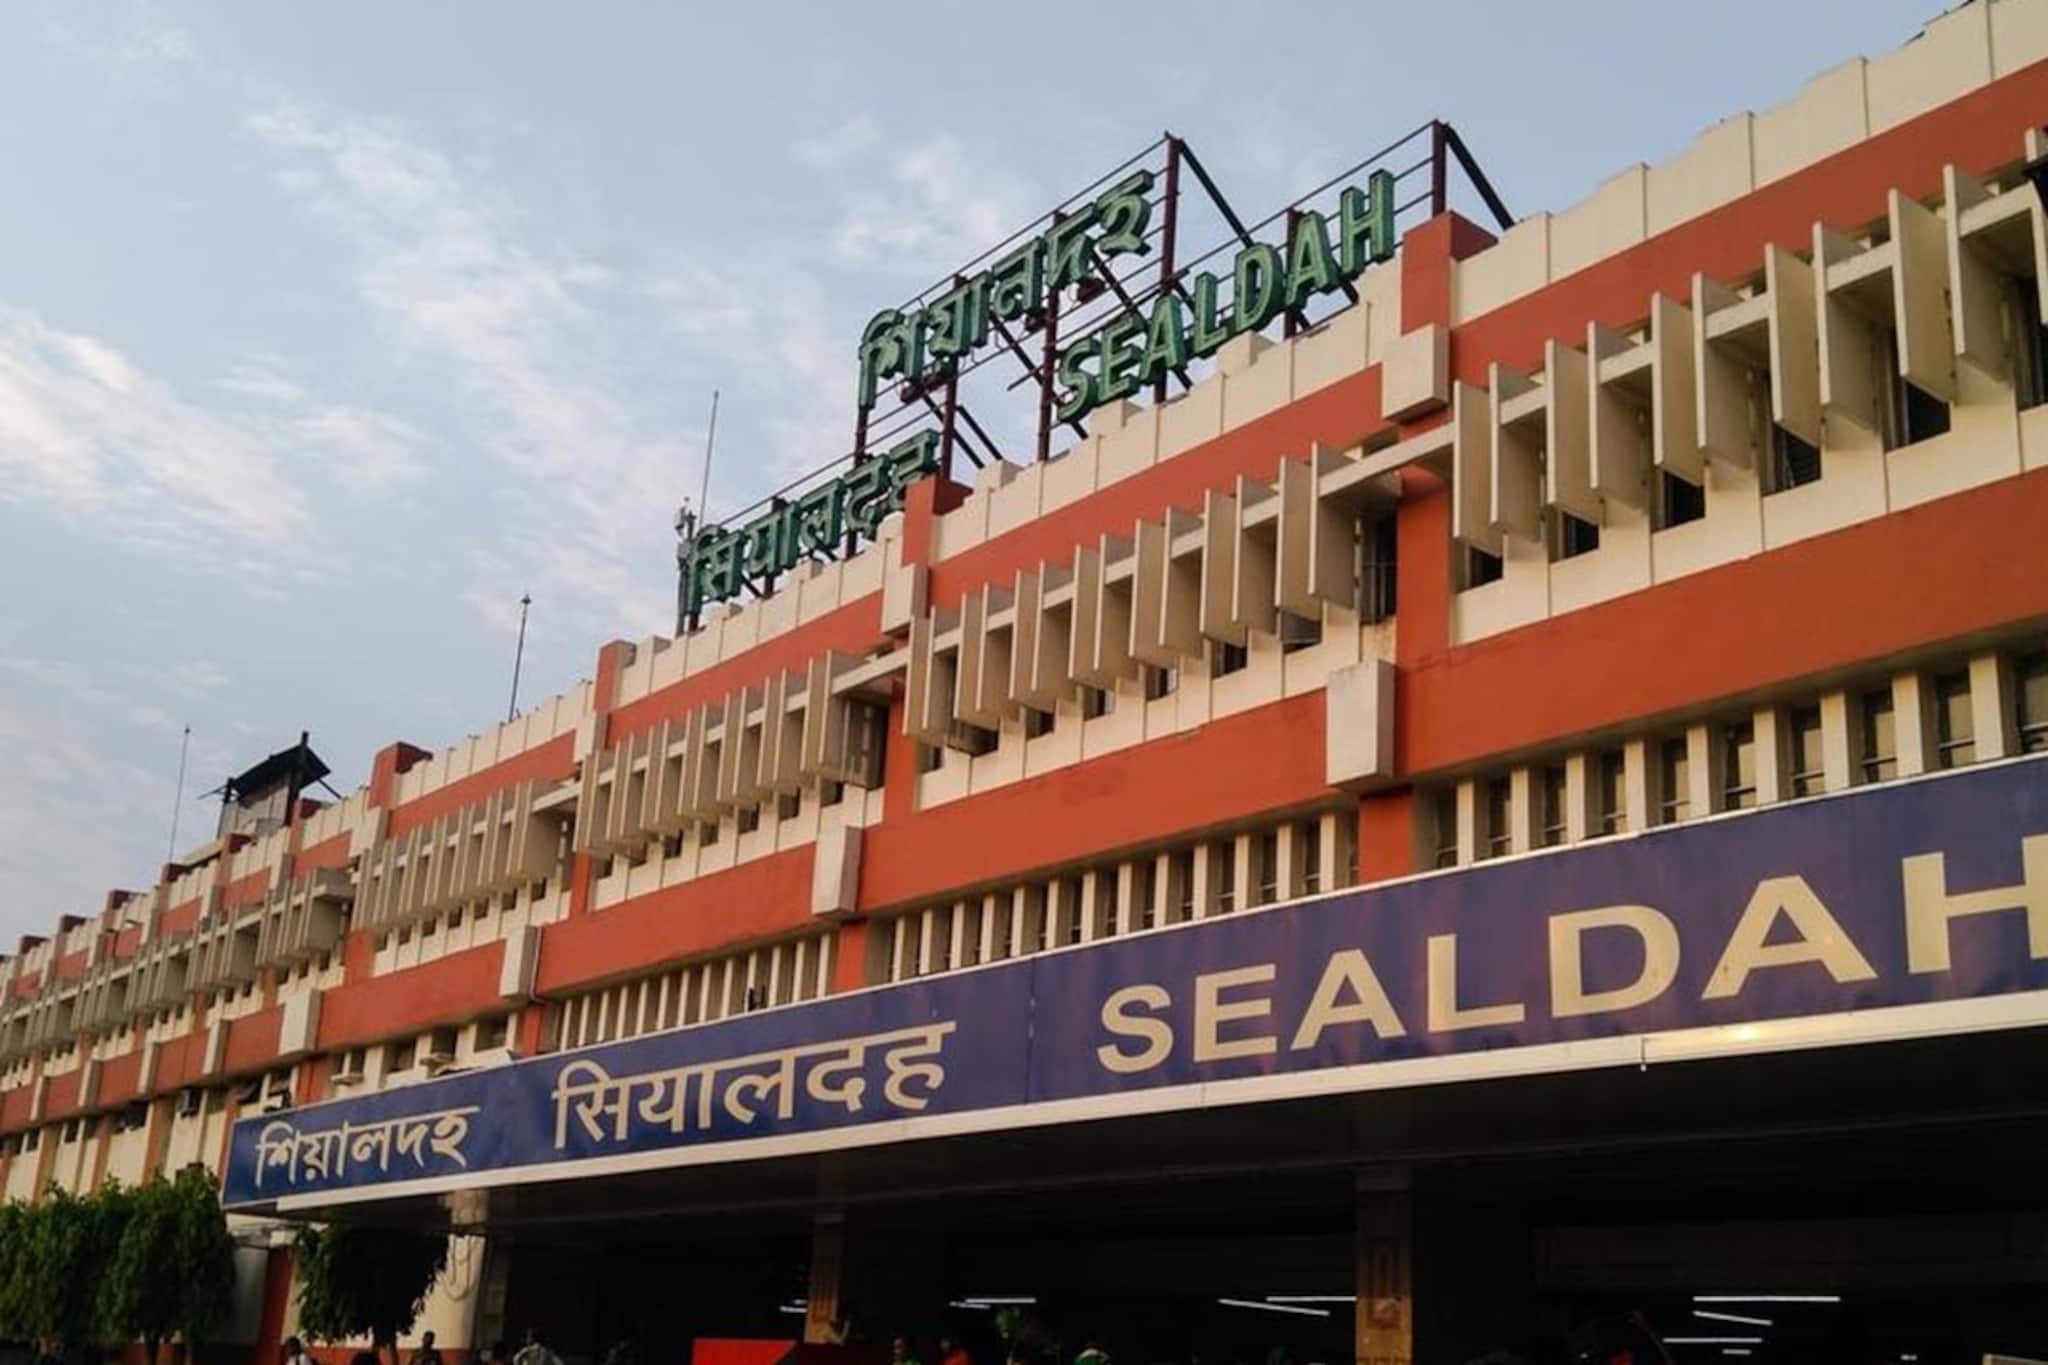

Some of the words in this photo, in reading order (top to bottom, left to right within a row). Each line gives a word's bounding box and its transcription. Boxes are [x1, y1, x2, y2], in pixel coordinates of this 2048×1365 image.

[1057, 169, 1395, 422] SEALDAH
[1096, 833, 2048, 1074] SEALDAH
[256, 1105, 480, 1187] শিয়ালদহ
[552, 1021, 957, 1149] सियालदह
